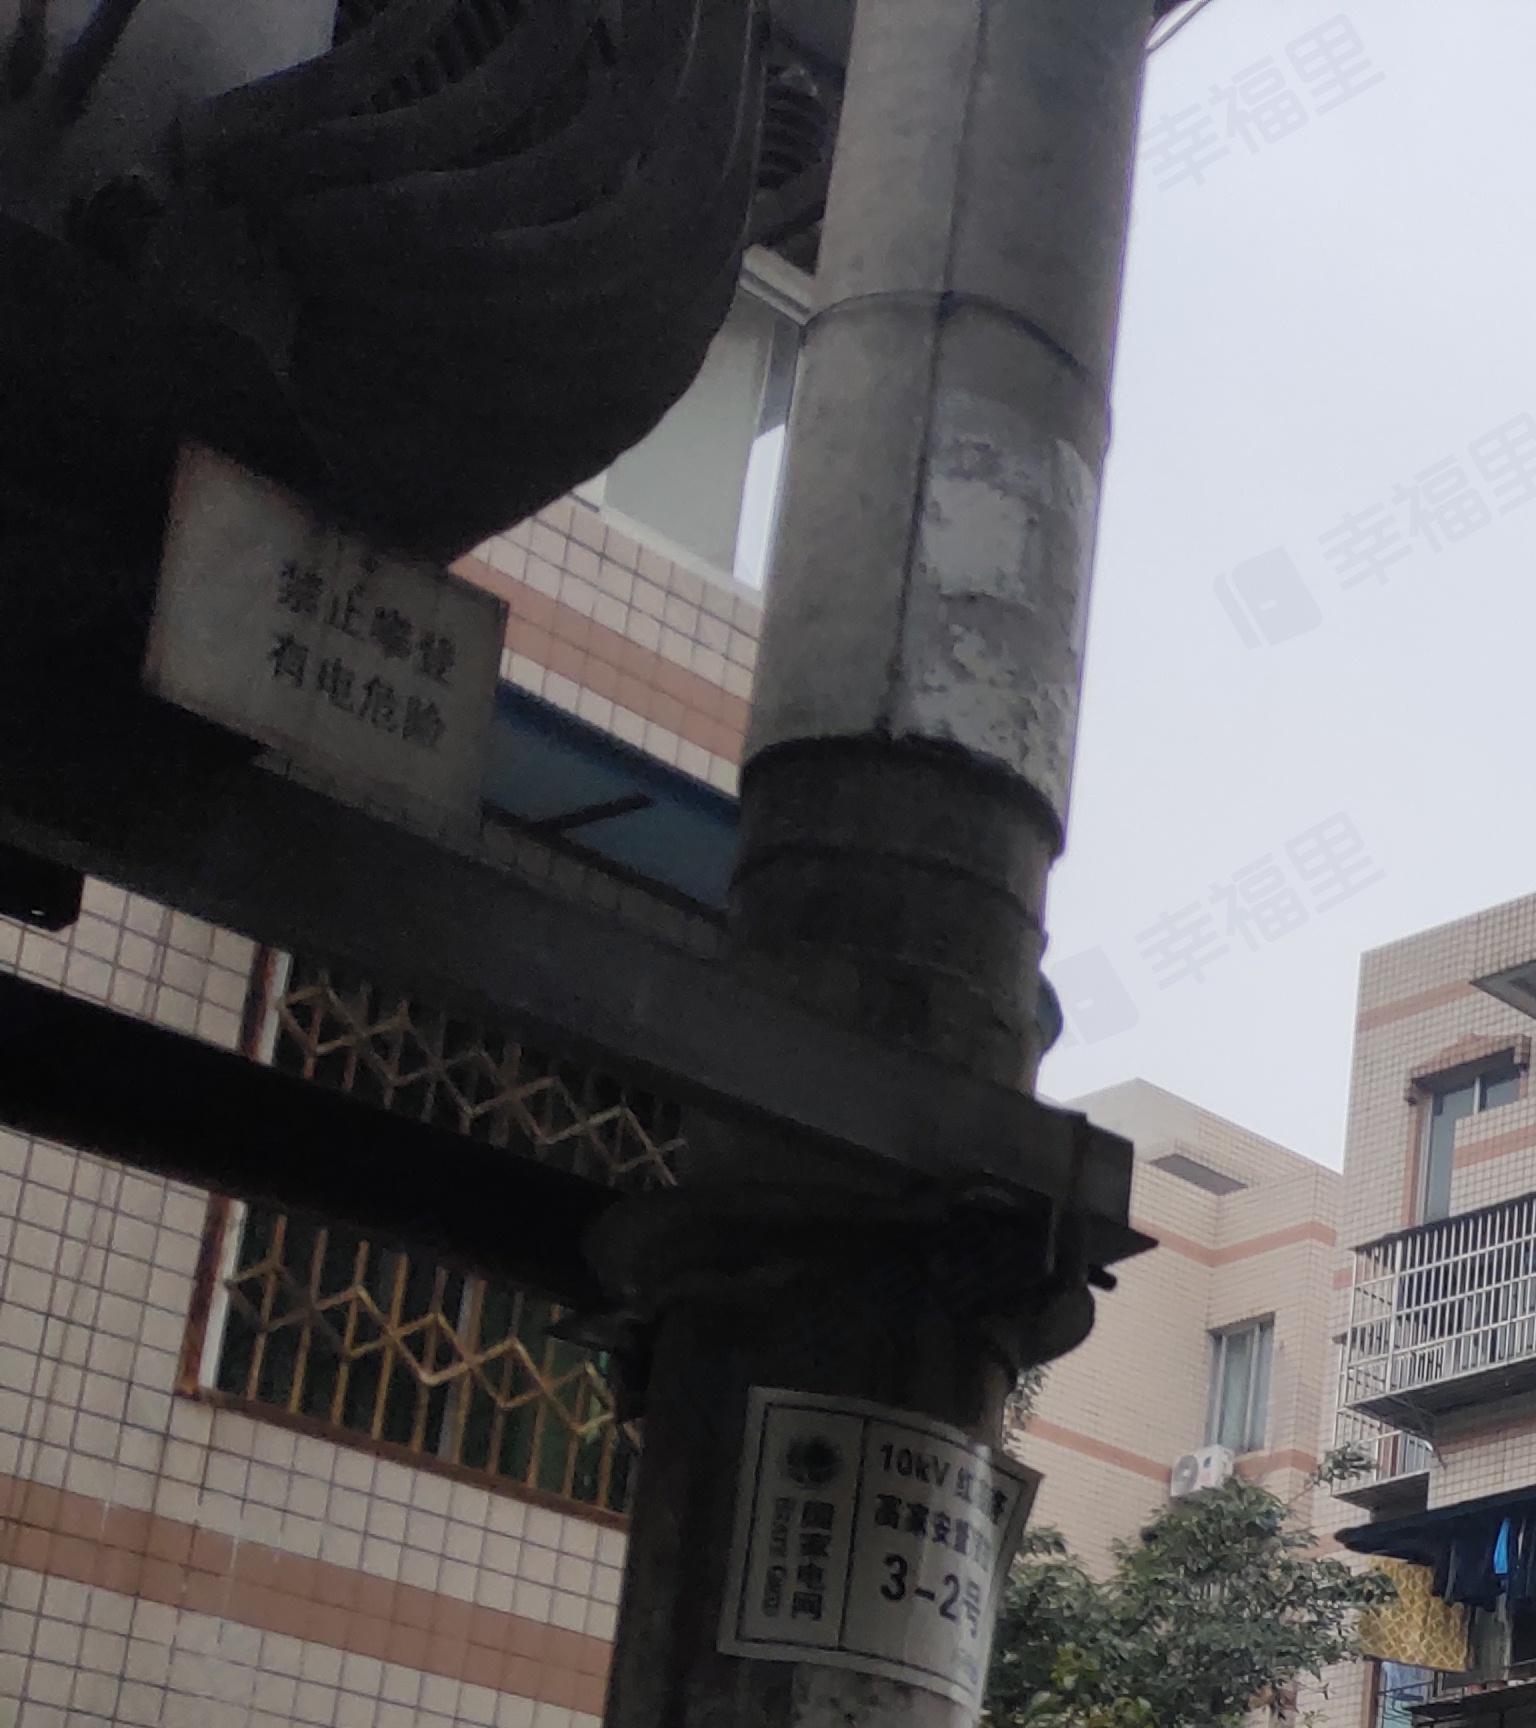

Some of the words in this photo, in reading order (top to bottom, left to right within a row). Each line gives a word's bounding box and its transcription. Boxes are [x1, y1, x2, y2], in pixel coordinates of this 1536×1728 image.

[269, 634, 444, 745] 有电危险
[880, 1441, 951, 1486] 10kV
